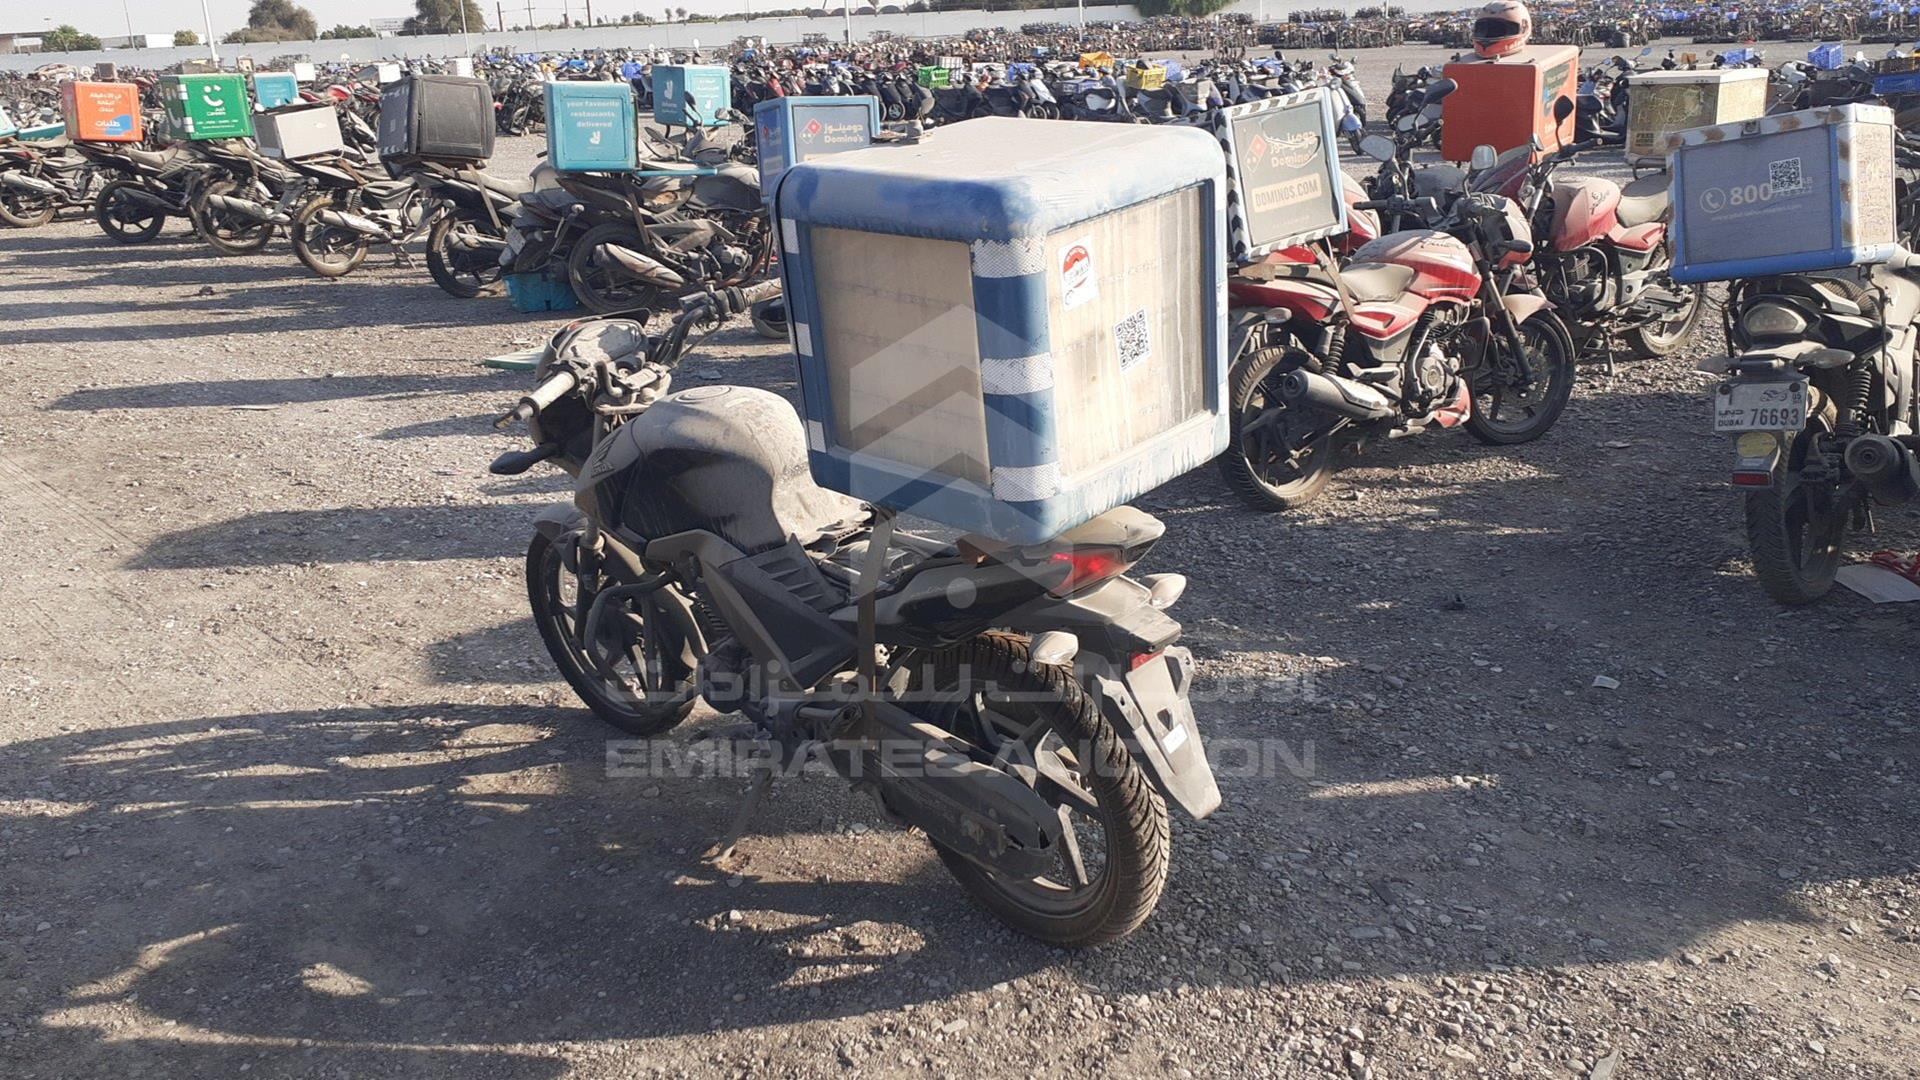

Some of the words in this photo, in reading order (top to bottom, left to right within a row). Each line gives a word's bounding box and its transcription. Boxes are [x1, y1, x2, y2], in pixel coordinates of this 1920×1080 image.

[824, 134, 864, 144] Domino's
[1255, 180, 1319, 207] DOMINOS.COM
[1730, 182, 1773, 205] 800
[1717, 419, 1744, 427] DUBAI
[1750, 408, 1800, 427] 76693
